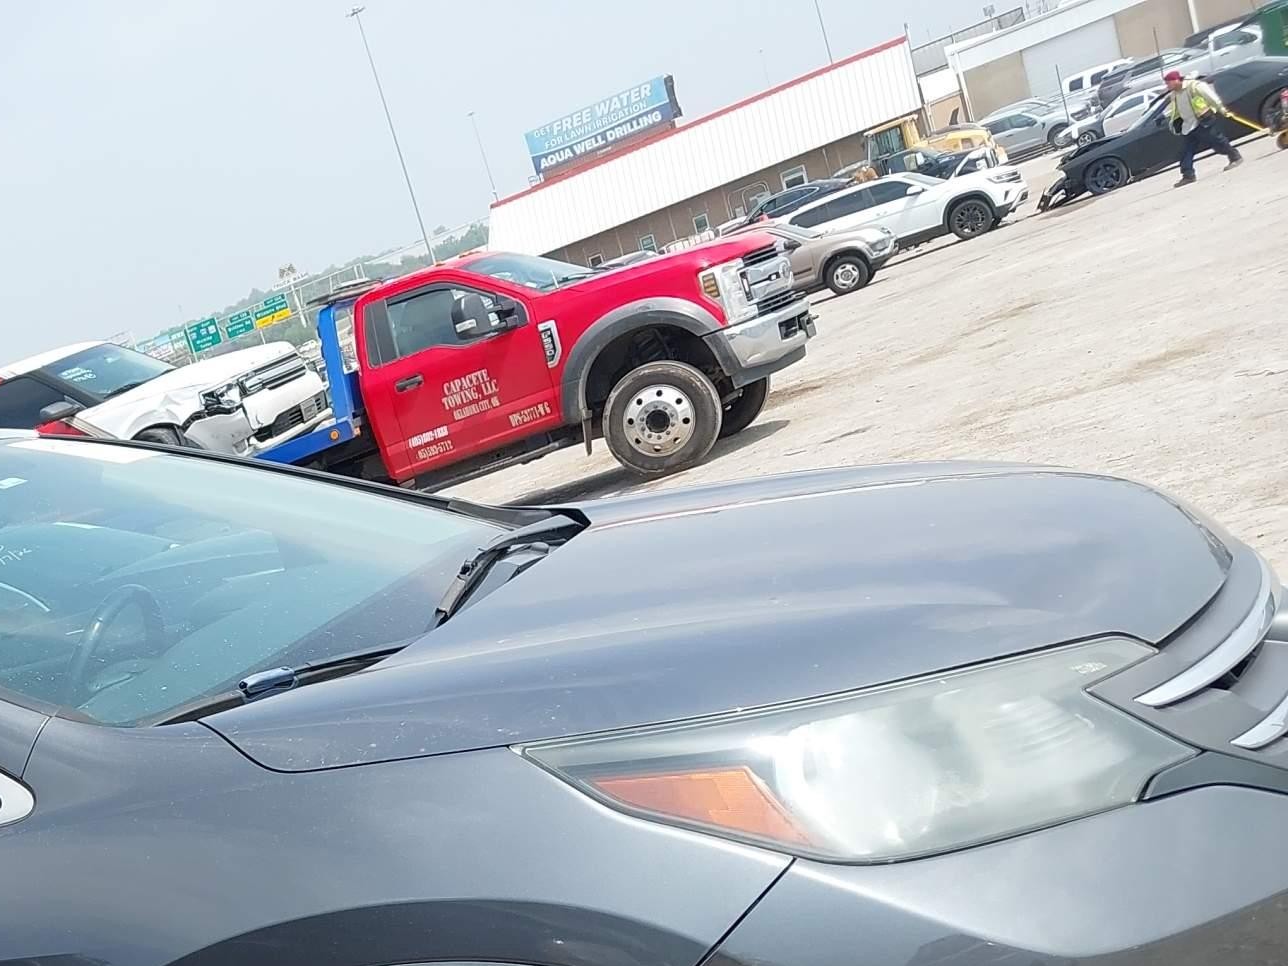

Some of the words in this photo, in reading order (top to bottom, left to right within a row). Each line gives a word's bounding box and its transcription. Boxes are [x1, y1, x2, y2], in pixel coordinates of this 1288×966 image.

[534, 126, 551, 138] GET
[552, 108, 592, 135] FREE
[595, 83, 652, 117] WATER
[544, 136, 563, 149] FOR
[566, 126, 592, 142] LAWN
[592, 101, 647, 129] IRRIGATION
[540, 148, 573, 169] AQUA
[573, 135, 606, 156] WELL
[606, 111, 662, 141] DRILLING
[441, 386, 482, 410] TOWING,
[482, 379, 500, 395] LLC
[443, 368, 491, 396] CAPACETE
